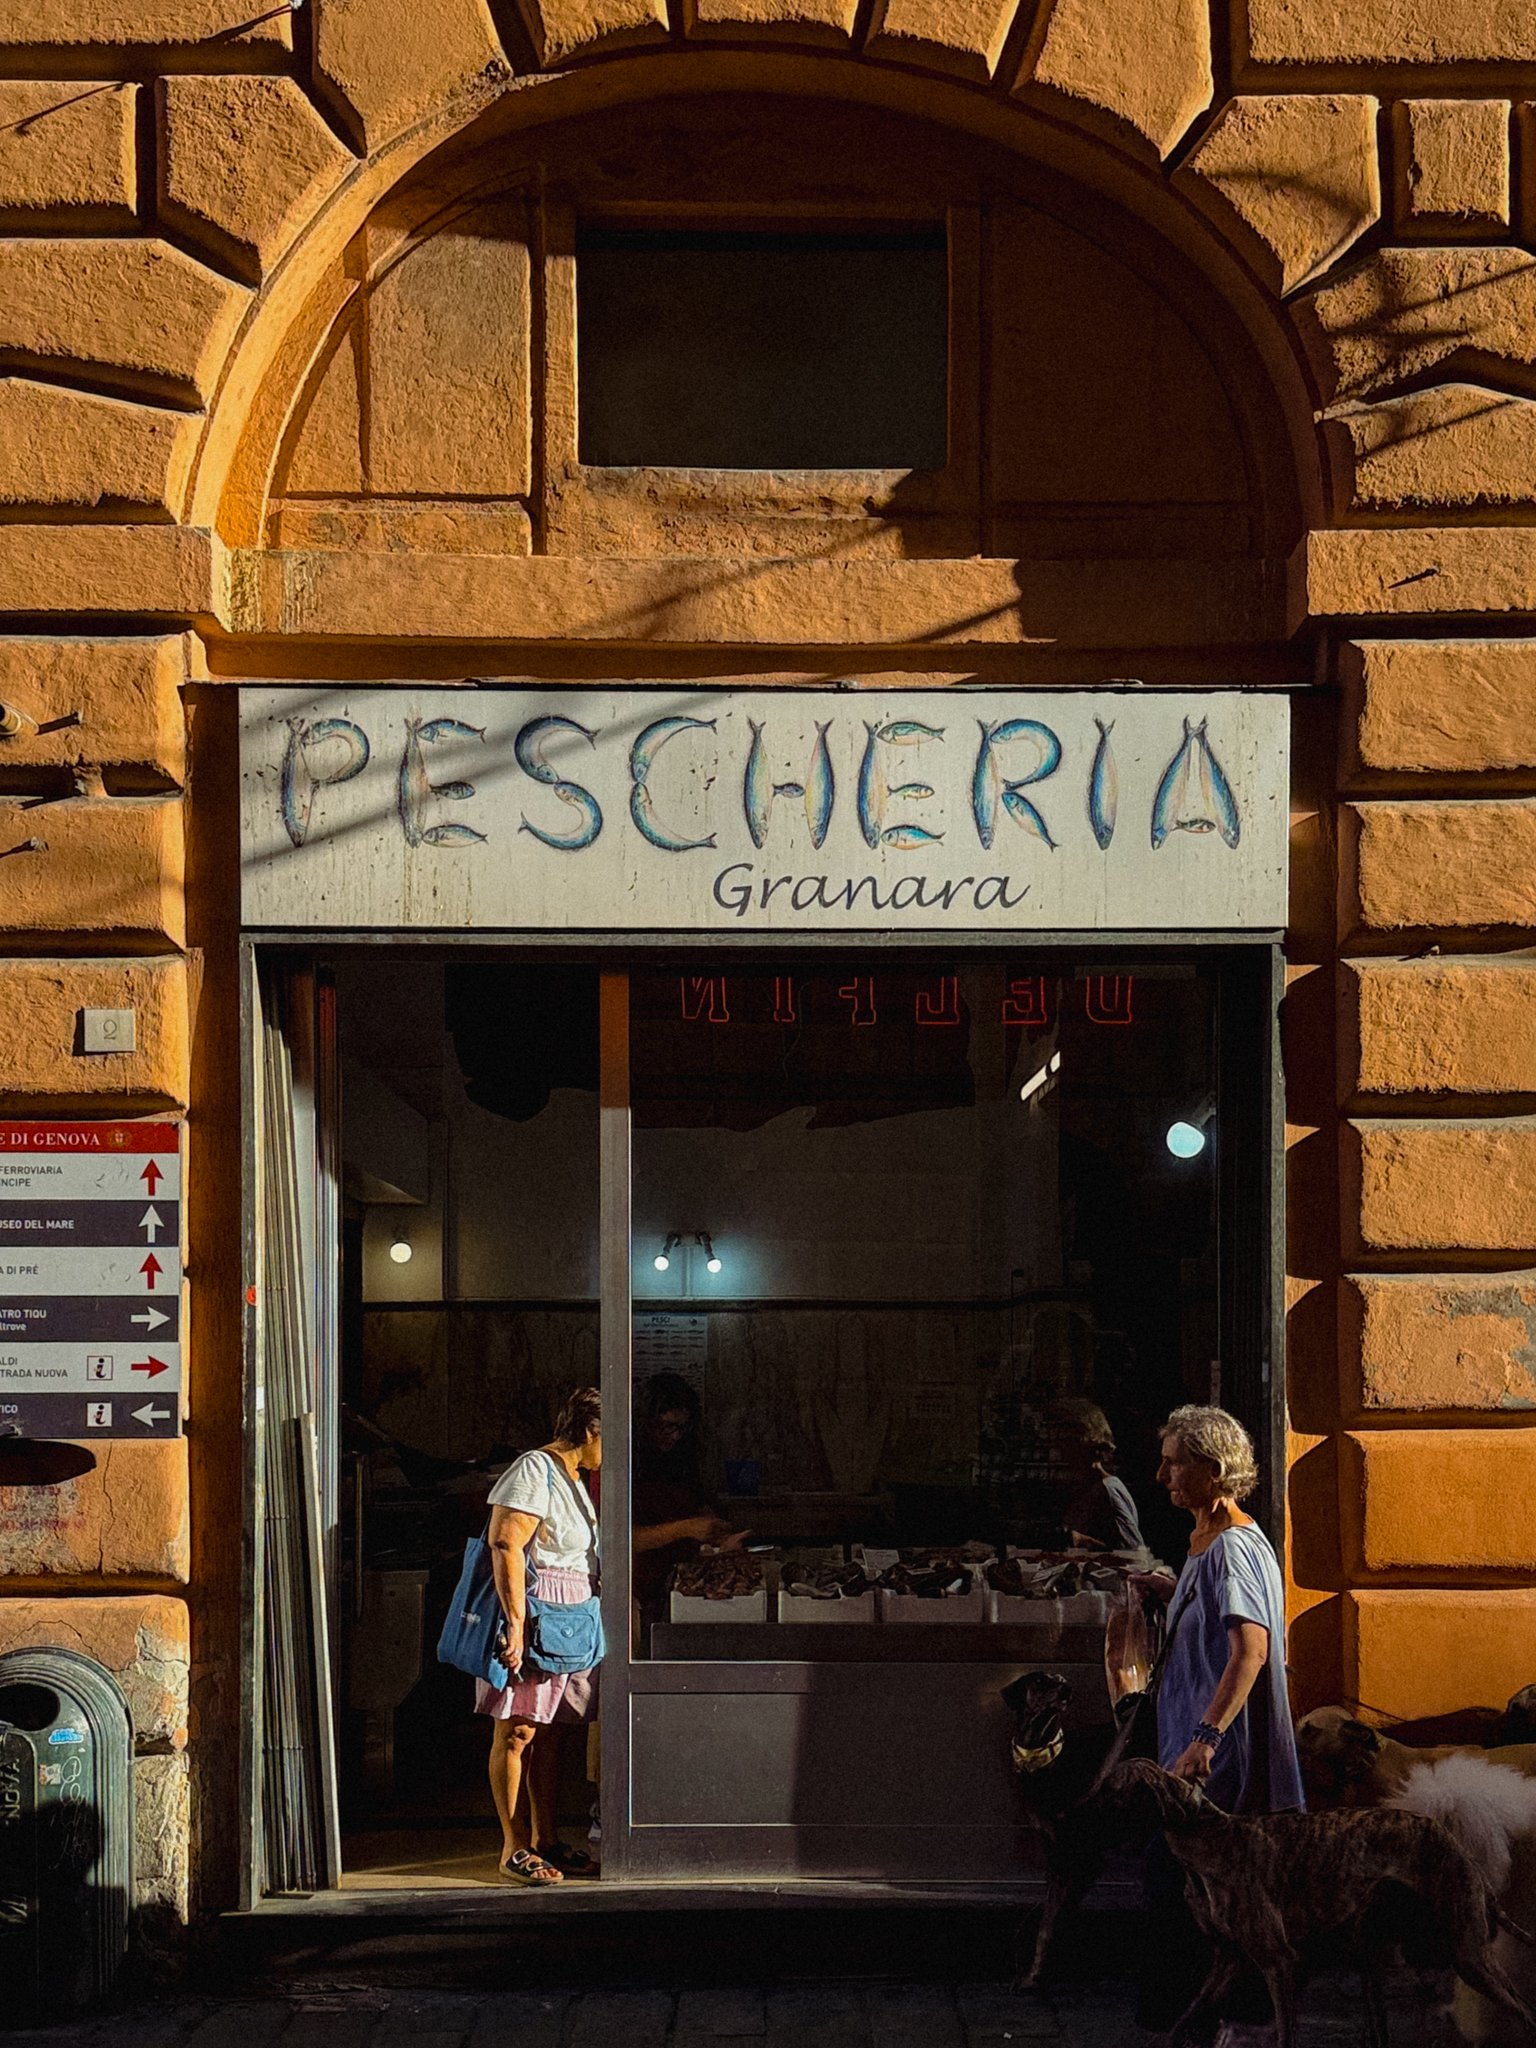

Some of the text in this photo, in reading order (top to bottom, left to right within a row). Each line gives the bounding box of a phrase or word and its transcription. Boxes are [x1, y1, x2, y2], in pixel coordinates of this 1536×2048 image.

[281, 714, 1240, 851] PESCHERIA
[713, 863, 1031, 917] Granara
[103, 1019, 118, 1040] 2
[11, 1133, 28, 1145] DI
[33, 1133, 100, 1146] GENOVA
[24, 1219, 44, 1229] DEL
[46, 1219, 75, 1229] MARE
[6, 1266, 17, 1275] DI
[0, 1357, 18, 1366] LDI
[35, 1369, 68, 1378] NUOVA
